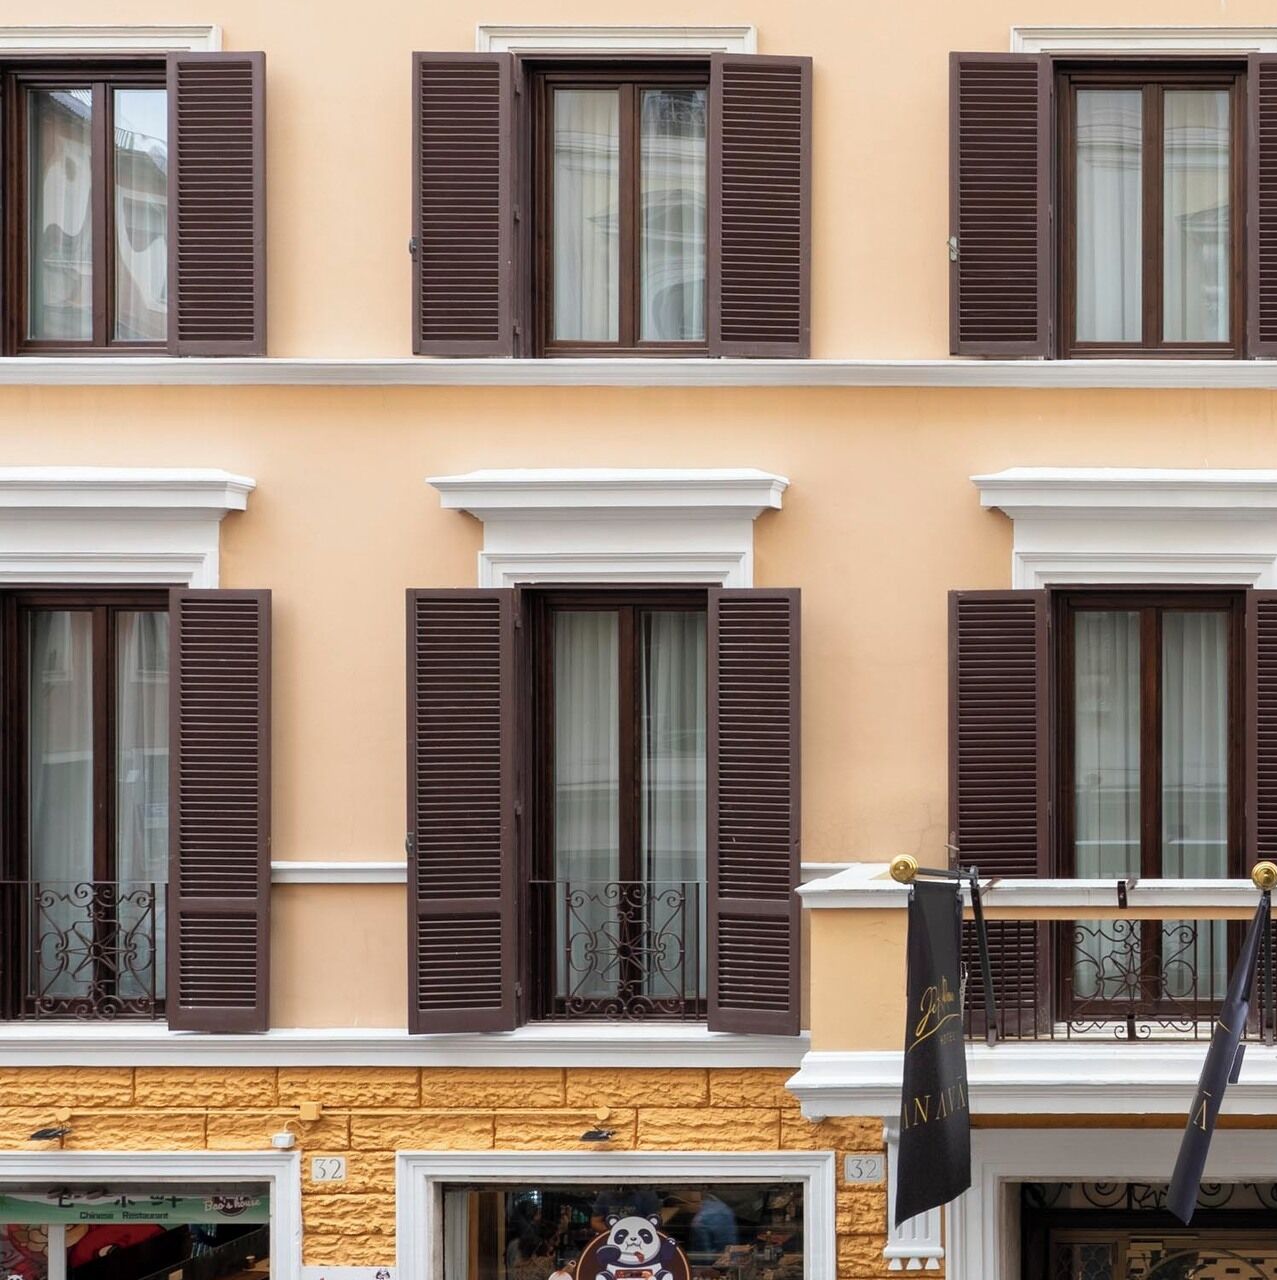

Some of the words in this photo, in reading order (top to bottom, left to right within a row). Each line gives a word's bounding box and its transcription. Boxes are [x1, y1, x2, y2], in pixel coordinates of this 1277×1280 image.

[315, 1158, 343, 1179] 32
[851, 1158, 877, 1179] 32
[80, 1211, 114, 1220] Chinese
[122, 1211, 169, 1220] Restaurant
